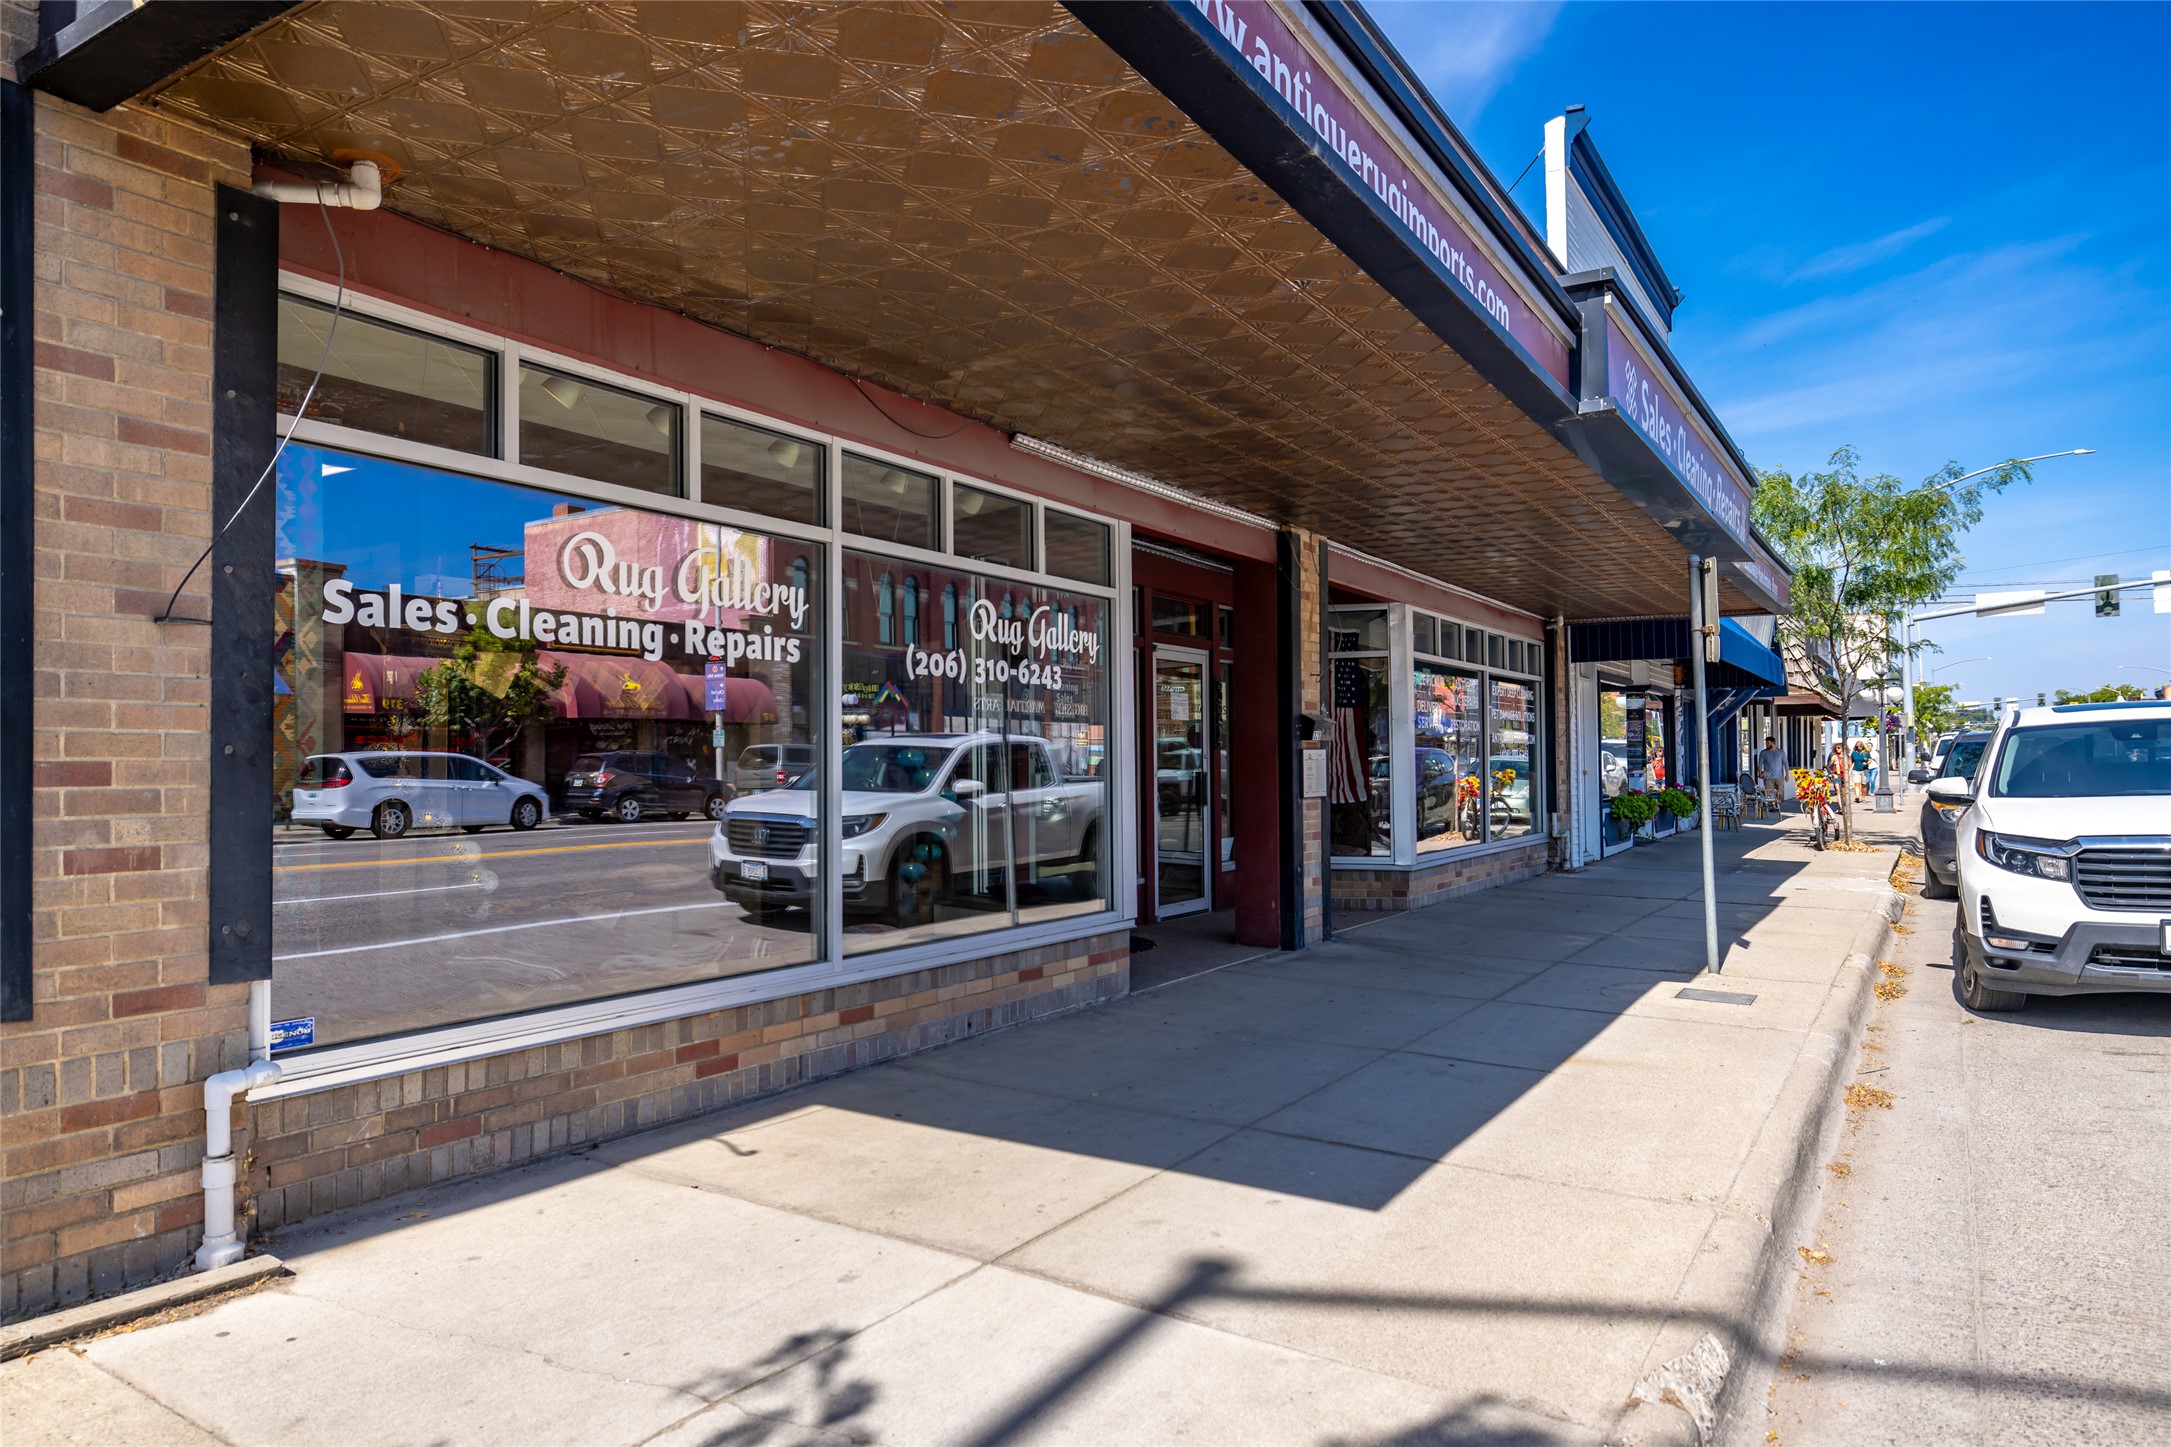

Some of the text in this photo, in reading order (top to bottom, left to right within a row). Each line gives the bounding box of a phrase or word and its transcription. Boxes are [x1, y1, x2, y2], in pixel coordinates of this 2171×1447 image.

[1641, 379, 1741, 535] Sales Cleaning Repairs
[322, 578, 801, 668] Sales Cleaning Repairs
[563, 531, 810, 630] Rug Gallery
[906, 642, 1063, 690] (206) 310-6243
[970, 598, 1100, 665] Rug Gallery
